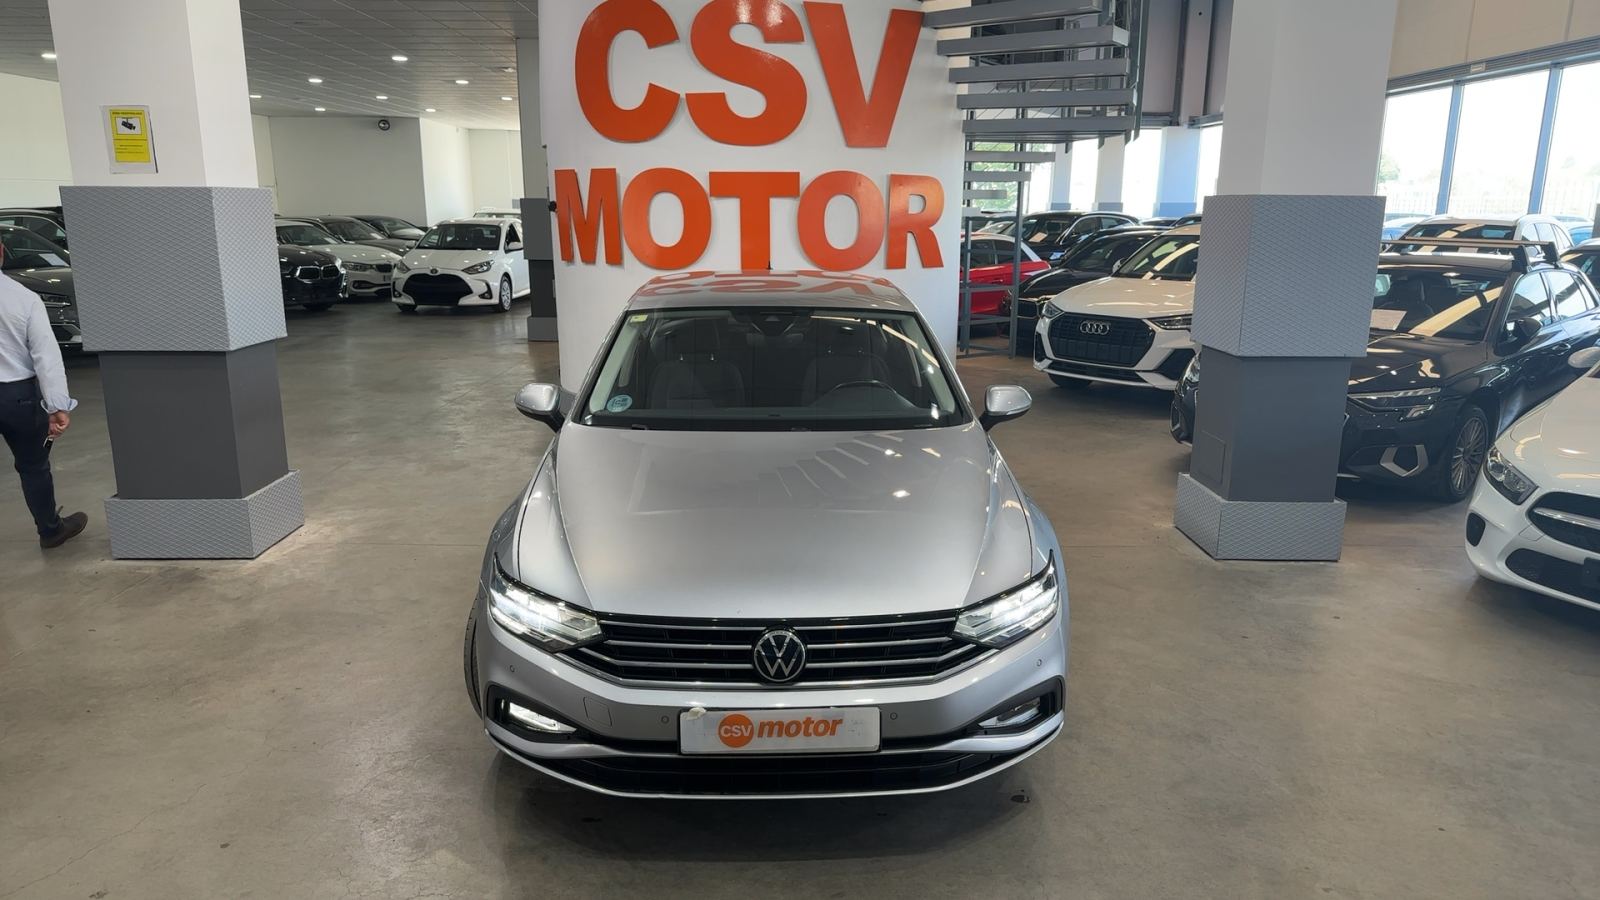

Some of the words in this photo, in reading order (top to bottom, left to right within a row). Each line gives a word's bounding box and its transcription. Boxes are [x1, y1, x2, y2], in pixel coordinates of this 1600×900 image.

[575, 0, 923, 148] CSV
[554, 167, 945, 271] MOTOR
[720, 725, 752, 738] CSV
[757, 716, 843, 738] motor
